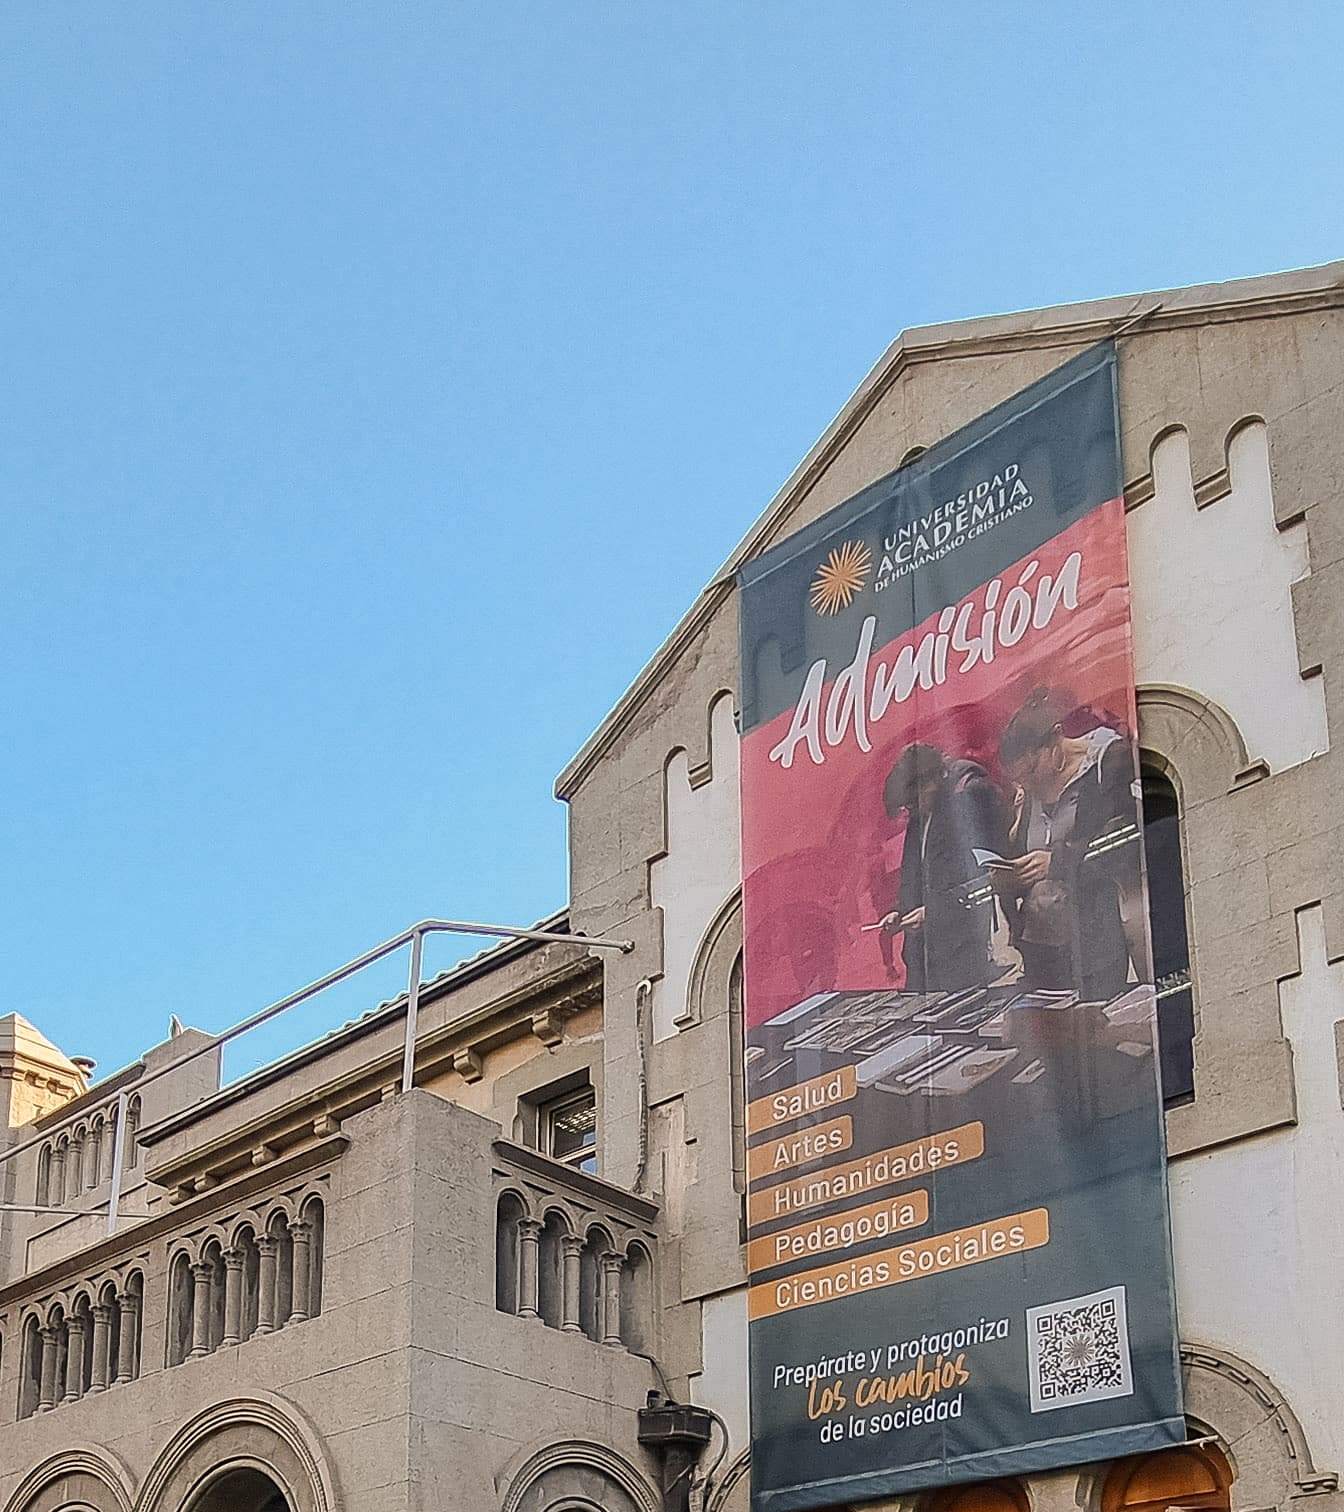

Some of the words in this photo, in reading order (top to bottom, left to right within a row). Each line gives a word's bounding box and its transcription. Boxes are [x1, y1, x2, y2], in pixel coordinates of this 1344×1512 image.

[873, 578, 890, 593] DE
[890, 533, 966, 587] HUMANISMO
[966, 495, 1034, 545] CRISTIANO
[876, 478, 1029, 577] ACADEMIA
[883, 463, 1020, 551] UNIVERSIDAD
[768, 551, 1083, 769] Admisión
[772, 1073, 843, 1120] Salud
[772, 1124, 844, 1169] Artes
[773, 1137, 960, 1215] Humanidades
[774, 1202, 916, 1263] Pedagogía
[775, 1256, 890, 1309] Ciencias
[897, 1222, 1026, 1275] Sociales
[772, 1348, 867, 1390] Prepárate
[869, 1346, 883, 1374] y
[886, 1316, 1010, 1369] protagoniza
[855, 1351, 970, 1408] cambios
[819, 1417, 845, 1445] de
[848, 1415, 866, 1440] la
[869, 1392, 963, 1436] sociedad
